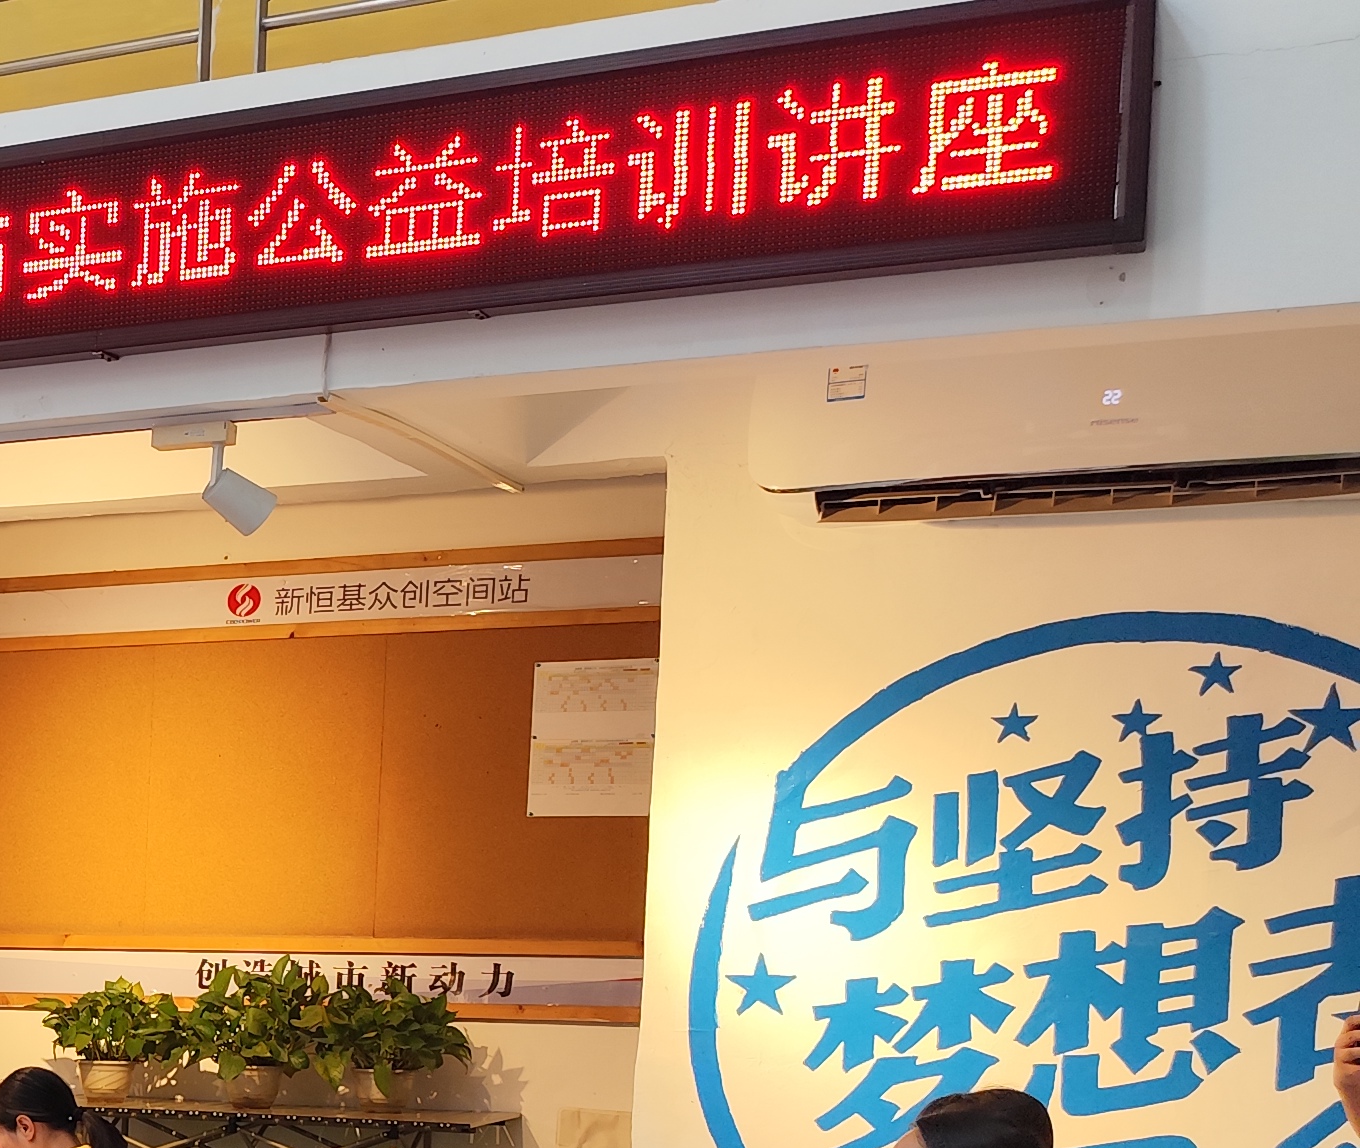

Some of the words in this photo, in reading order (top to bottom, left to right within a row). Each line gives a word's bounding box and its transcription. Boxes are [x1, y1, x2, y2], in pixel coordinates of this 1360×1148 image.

[1103, 389, 1122, 406] 22
[274, 573, 531, 616] 新恒基众创空间站
